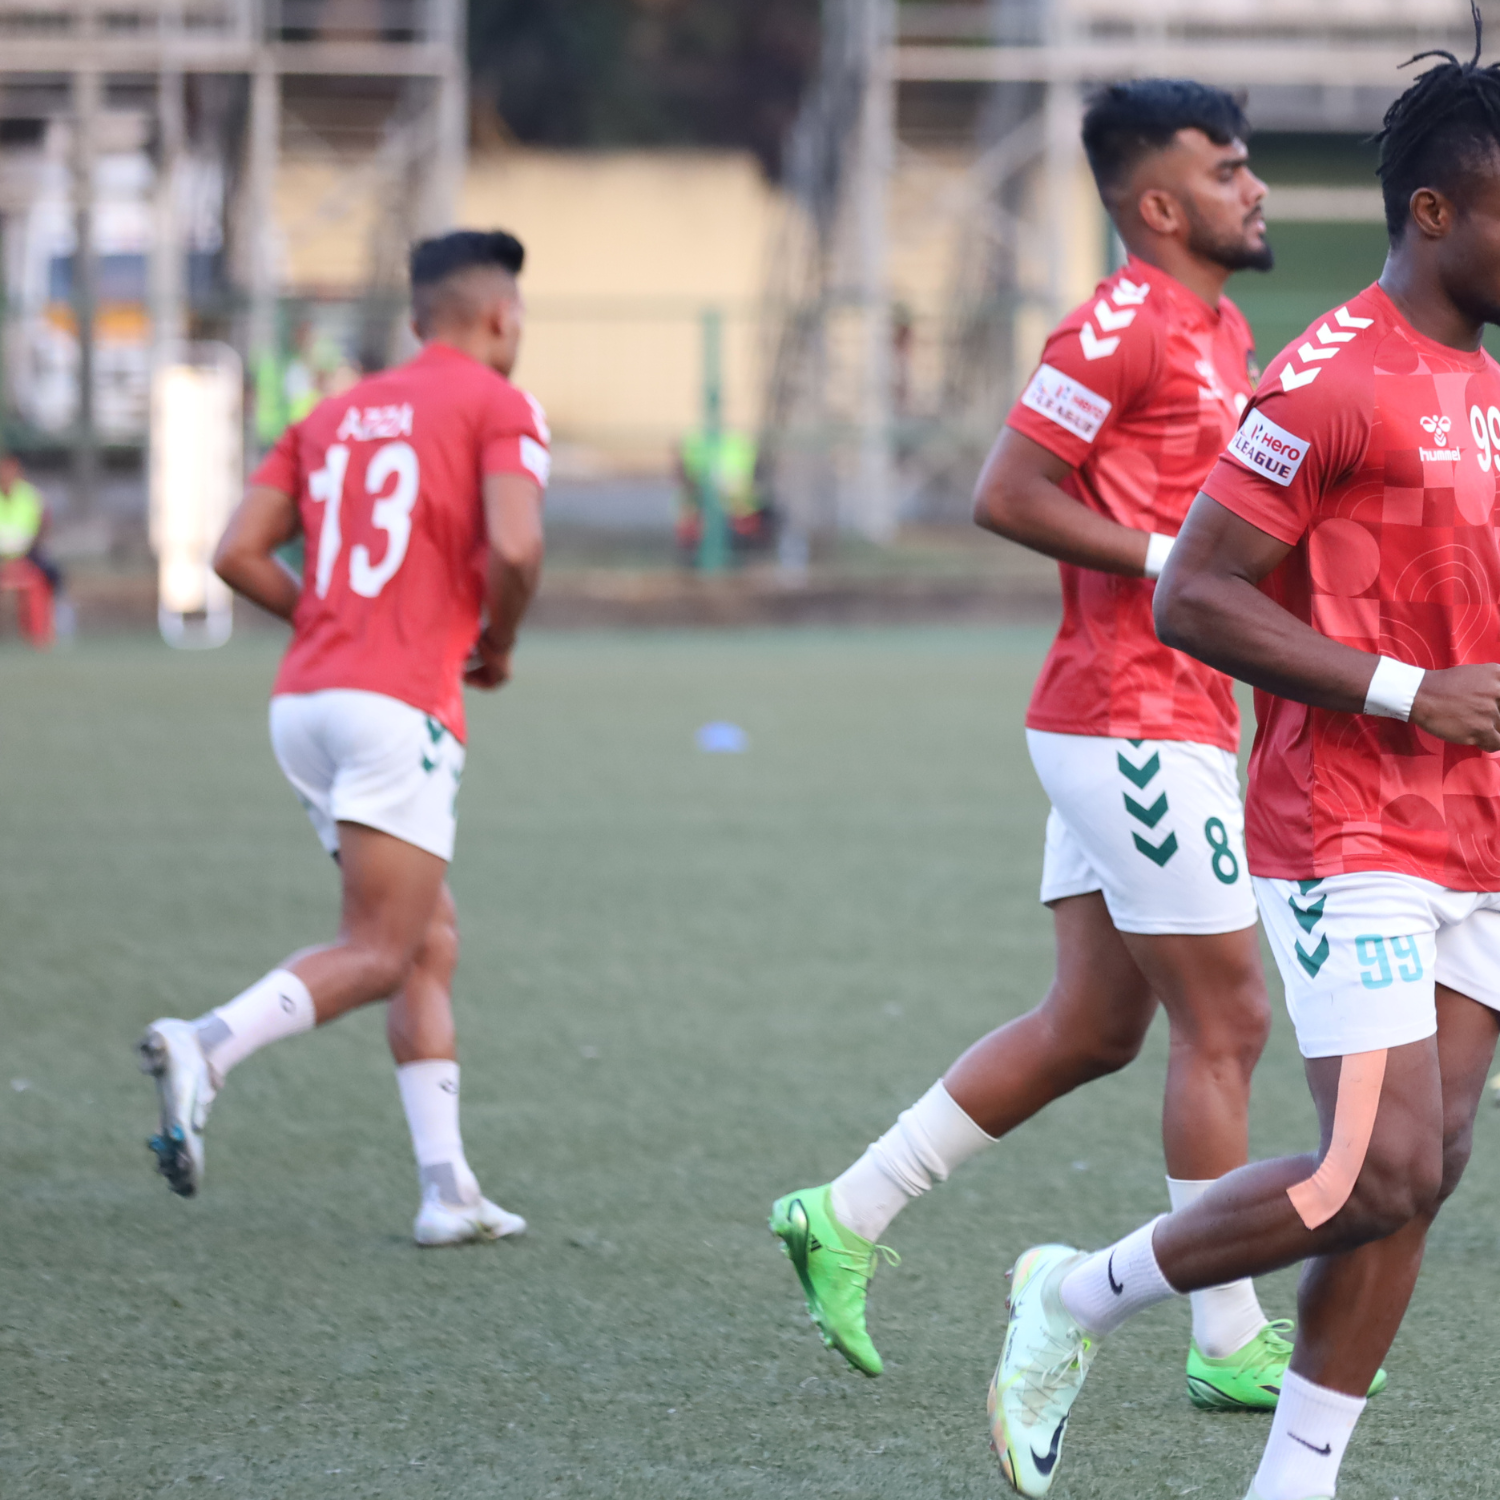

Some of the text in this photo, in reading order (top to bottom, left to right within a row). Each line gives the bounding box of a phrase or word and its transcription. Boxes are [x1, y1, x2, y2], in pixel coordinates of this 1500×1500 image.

[1261, 432, 1301, 461] Hero
[1419, 446, 1461, 462] hummel
[309, 442, 420, 599] 13
[1204, 816, 1239, 885] 8
[1354, 933, 1424, 990] 99
